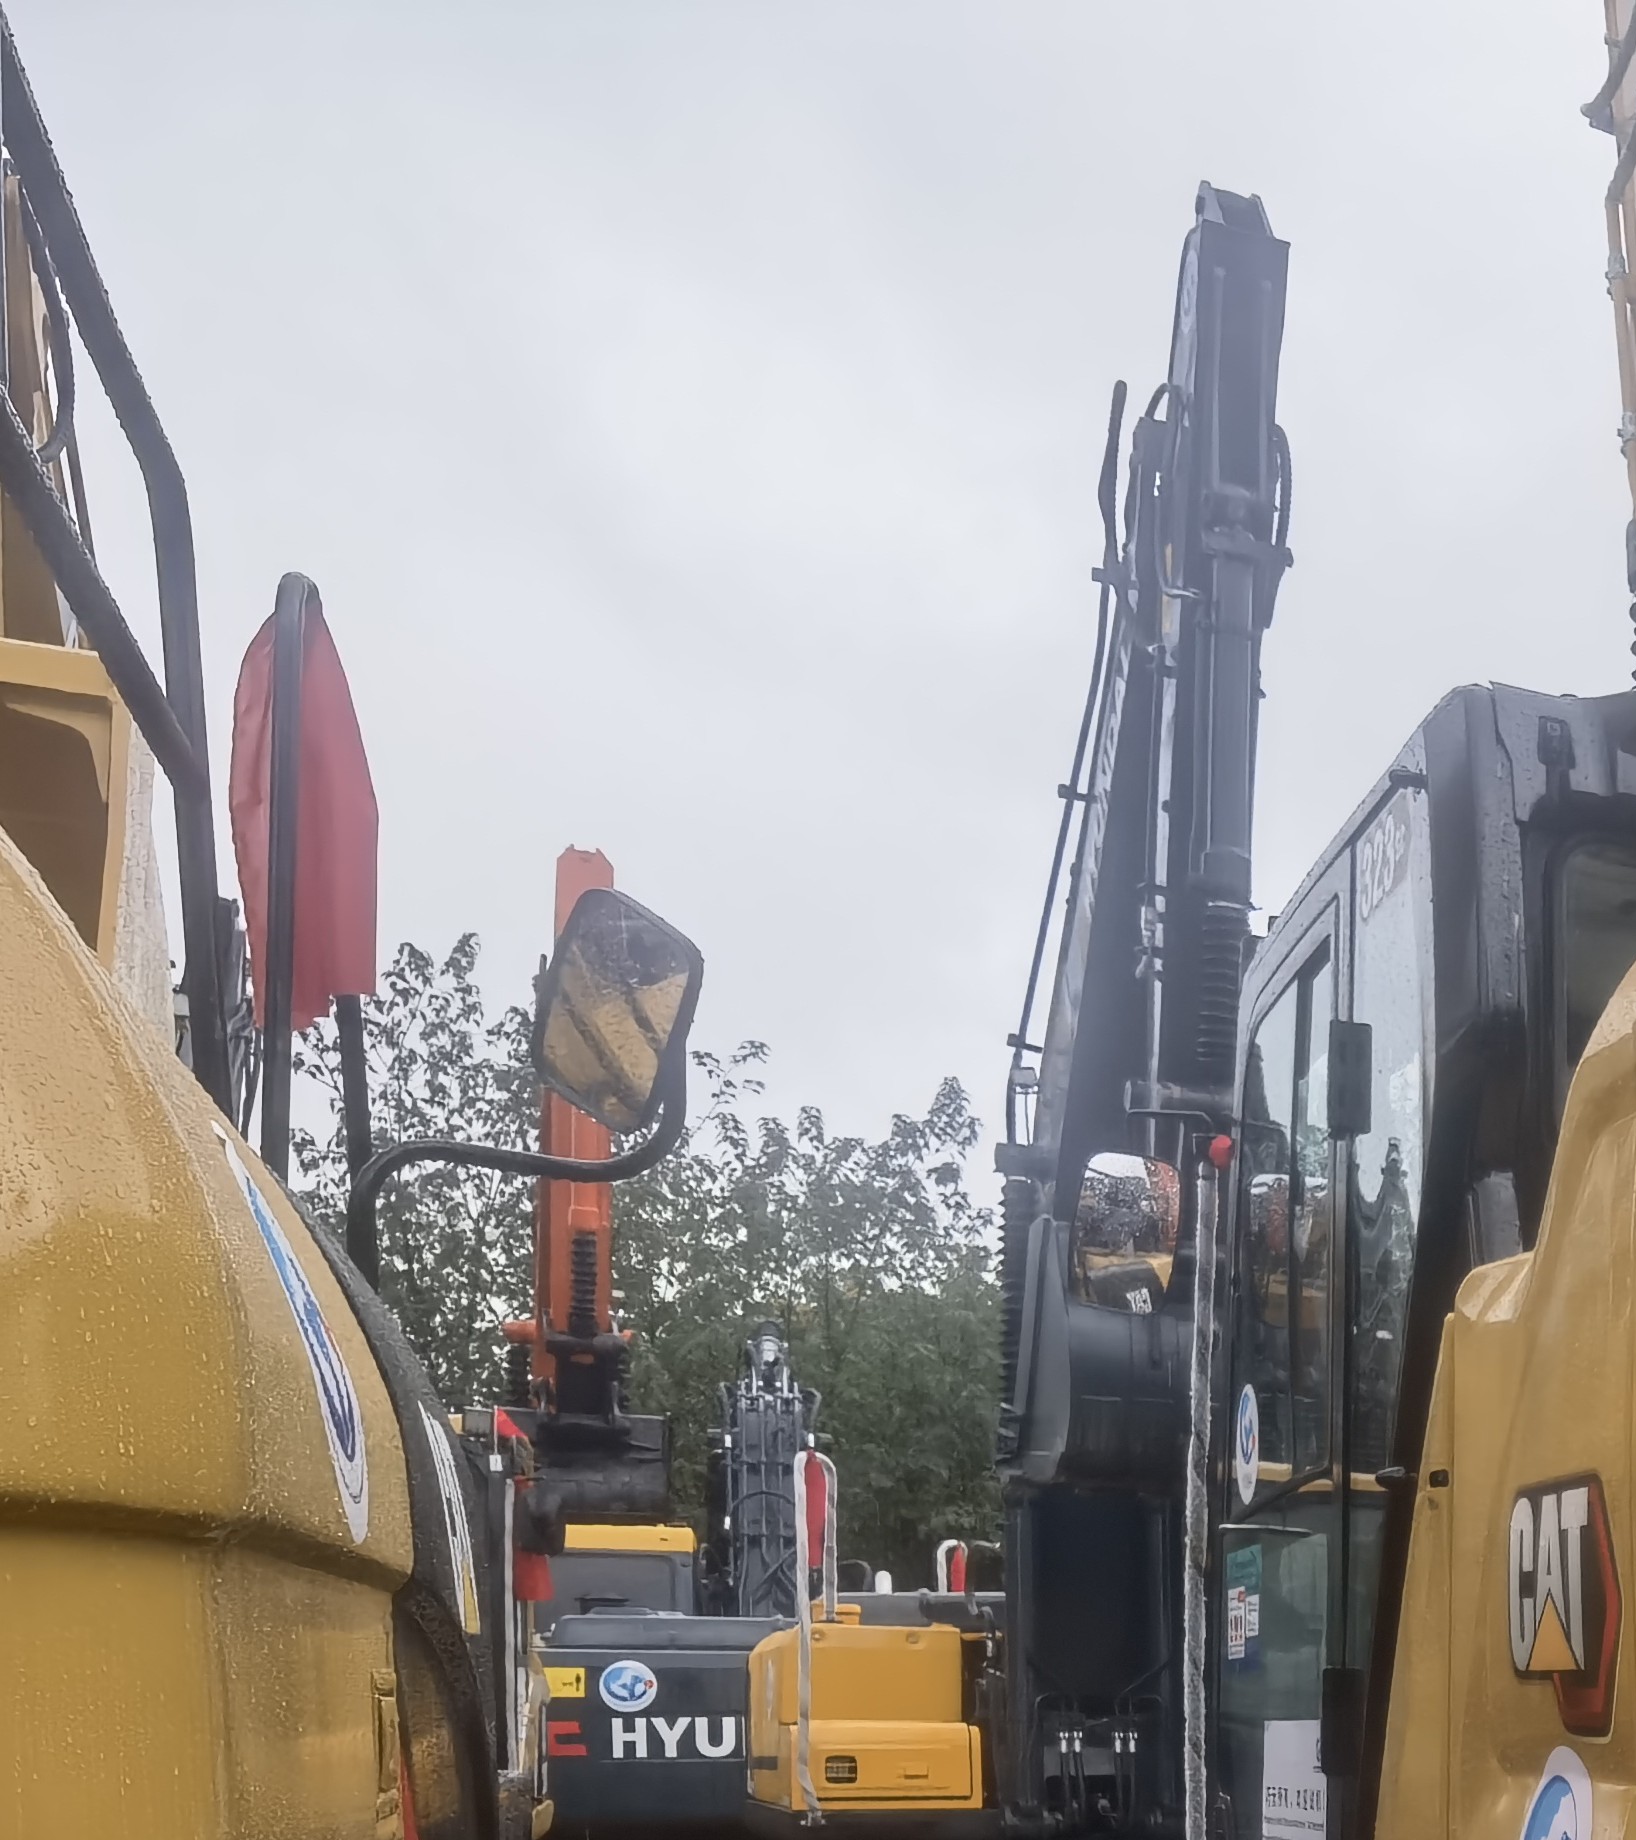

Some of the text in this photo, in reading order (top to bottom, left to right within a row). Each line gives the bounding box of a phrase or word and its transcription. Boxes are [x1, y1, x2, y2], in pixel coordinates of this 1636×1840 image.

[1361, 814, 1395, 919] 323
[1509, 1486, 1589, 1671] CAT
[611, 1716, 746, 1759] HYU
